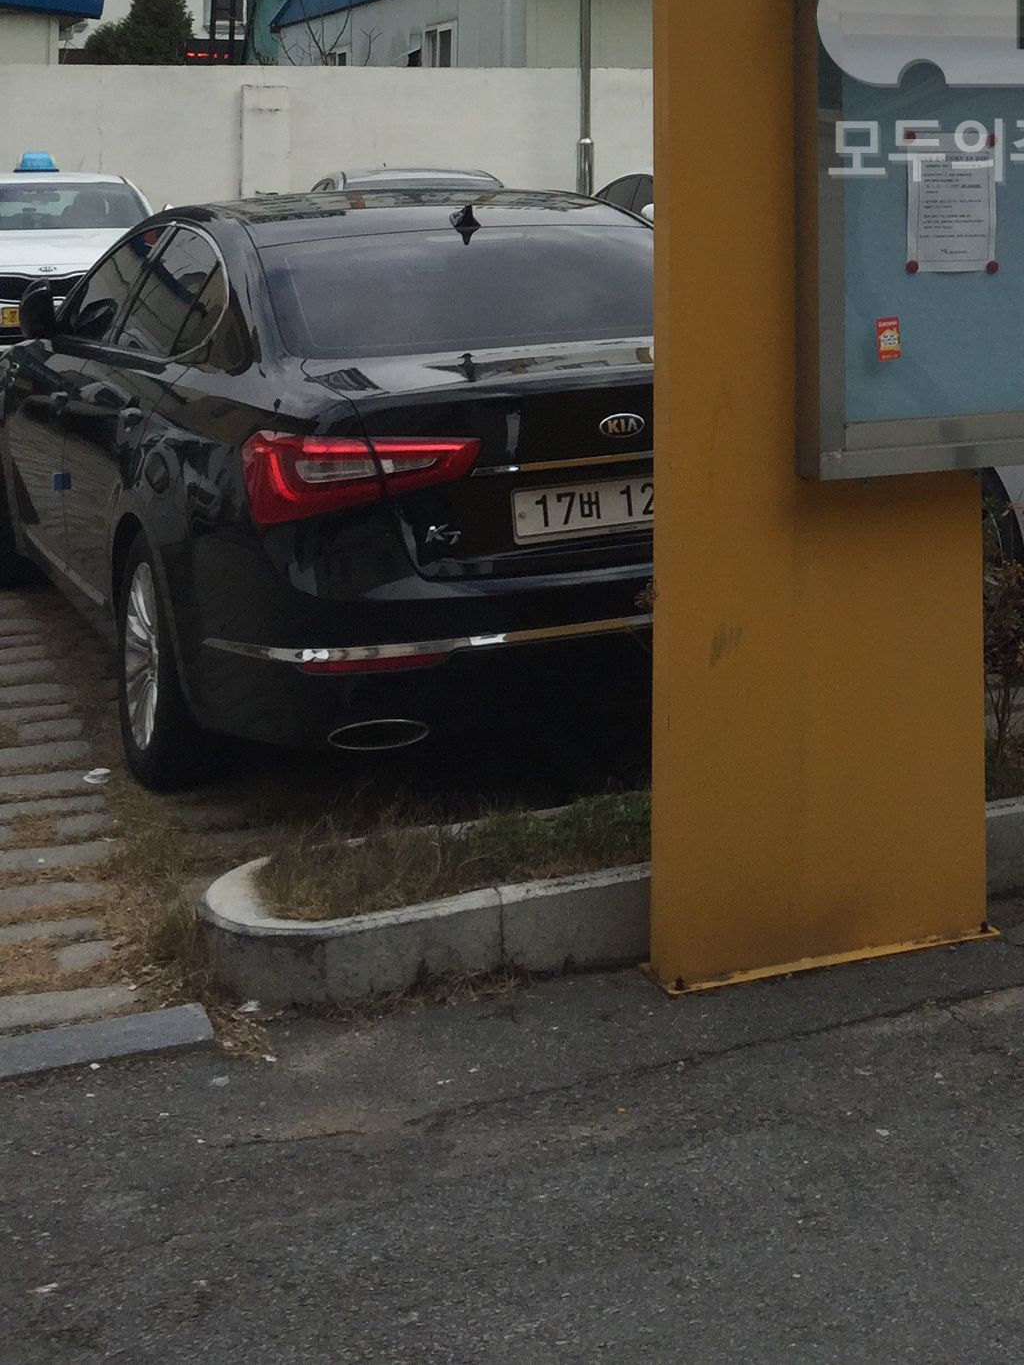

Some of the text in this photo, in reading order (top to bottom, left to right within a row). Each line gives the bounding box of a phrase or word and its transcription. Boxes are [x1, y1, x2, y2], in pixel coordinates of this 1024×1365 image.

[606, 419, 639, 433] KIA
[535, 491, 601, 527] 17버
[425, 523, 462, 545] K7
